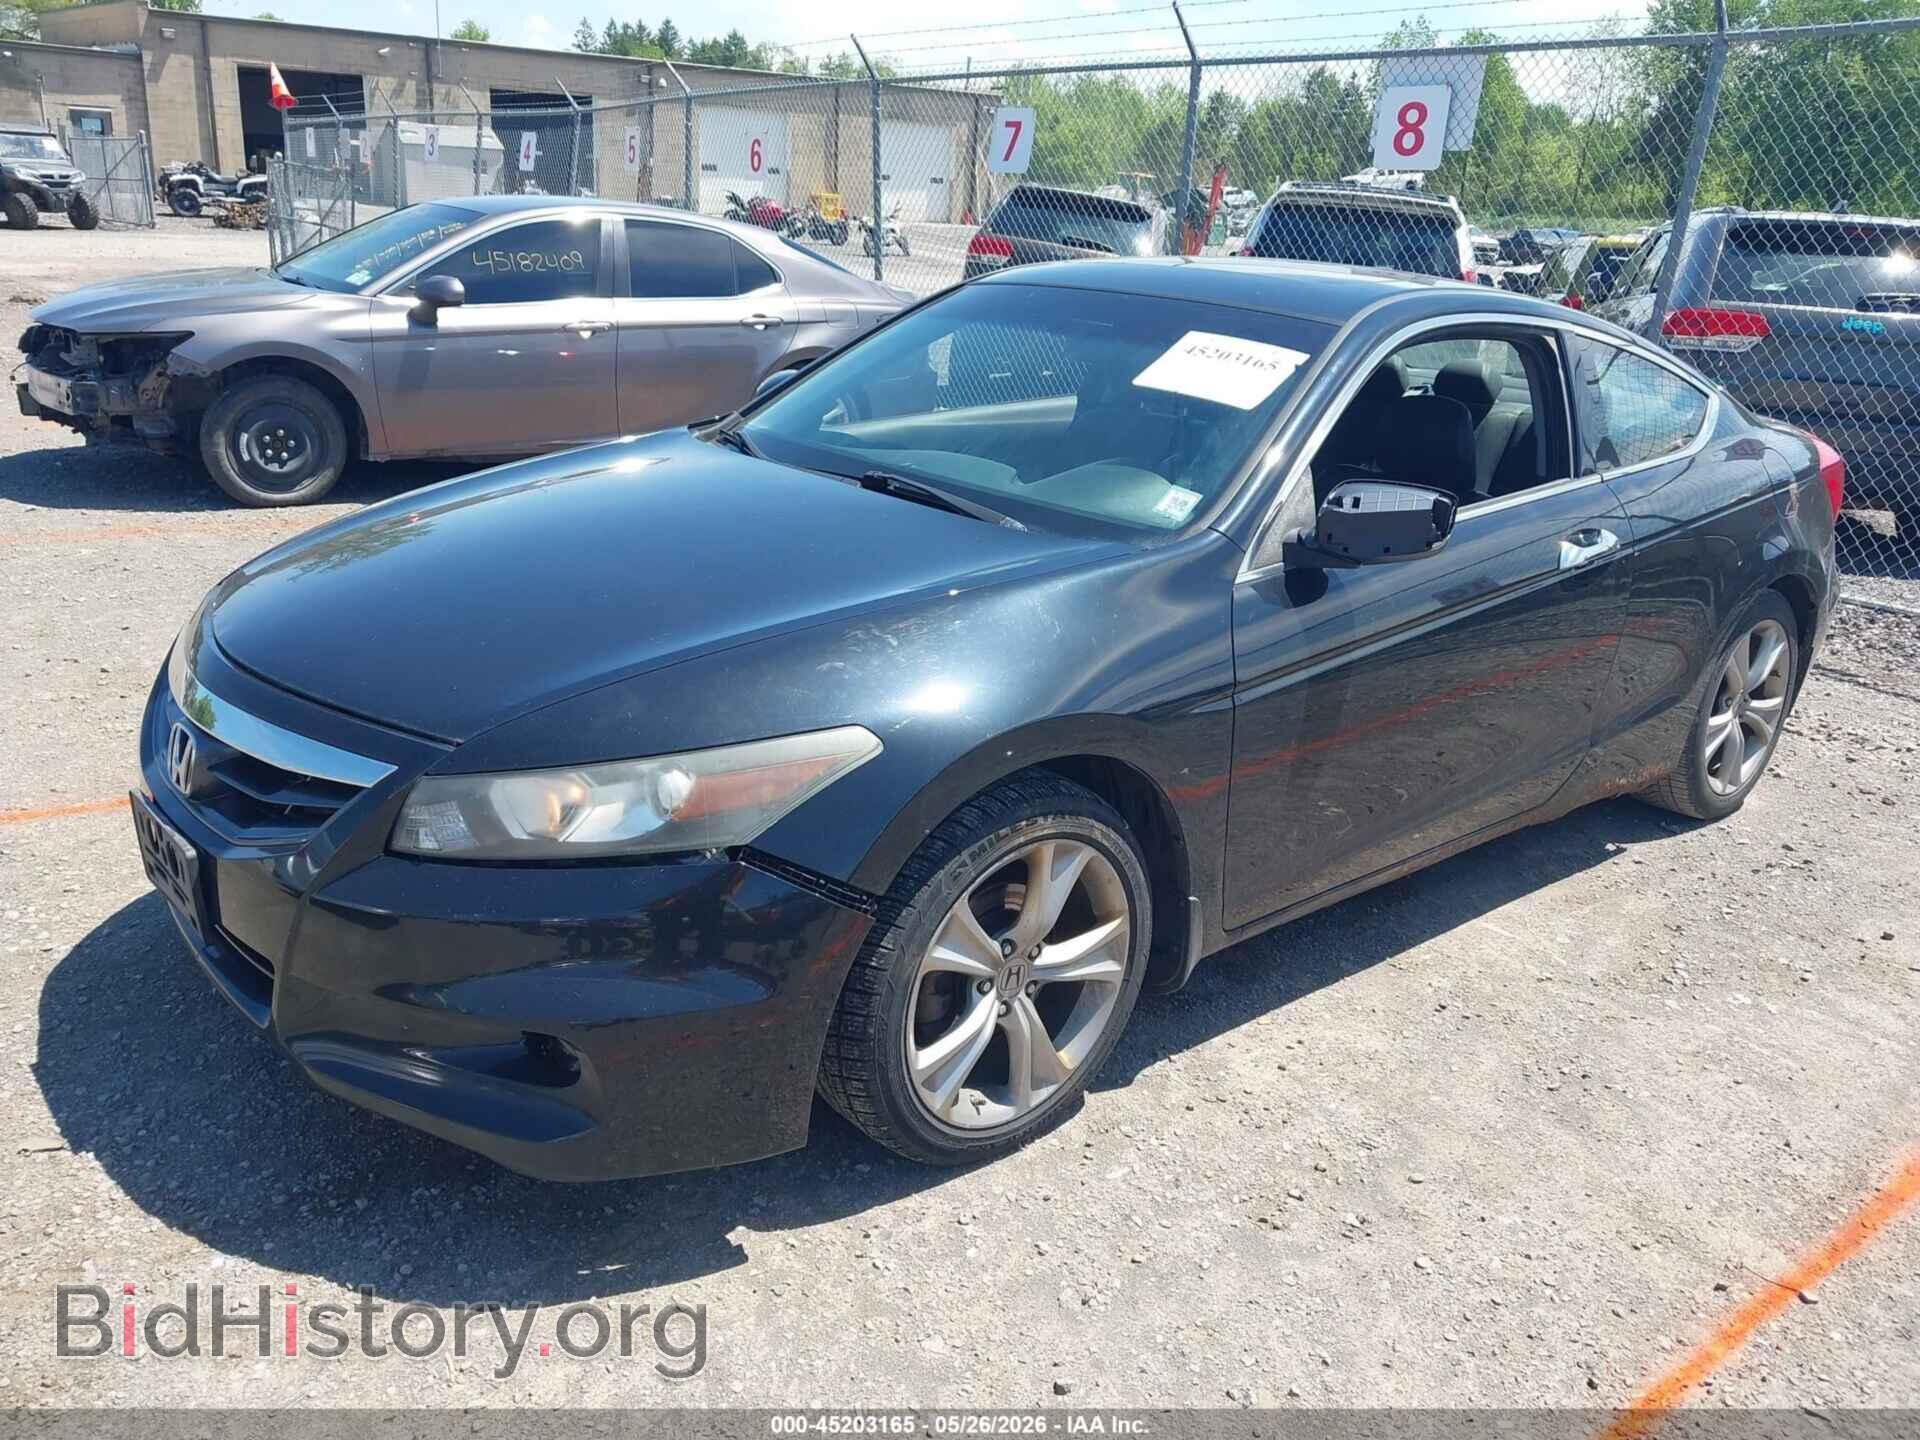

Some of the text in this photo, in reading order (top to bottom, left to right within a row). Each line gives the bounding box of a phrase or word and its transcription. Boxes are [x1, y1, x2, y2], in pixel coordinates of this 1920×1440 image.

[1003, 120, 1023, 162] 7
[1393, 101, 1428, 156] 8
[428, 134, 436, 157] 3
[523, 139, 532, 162] 4
[627, 135, 636, 164] 5
[750, 138, 762, 173] 6
[472, 249, 585, 275] 45182409
[1841, 315, 1885, 335] Jeep
